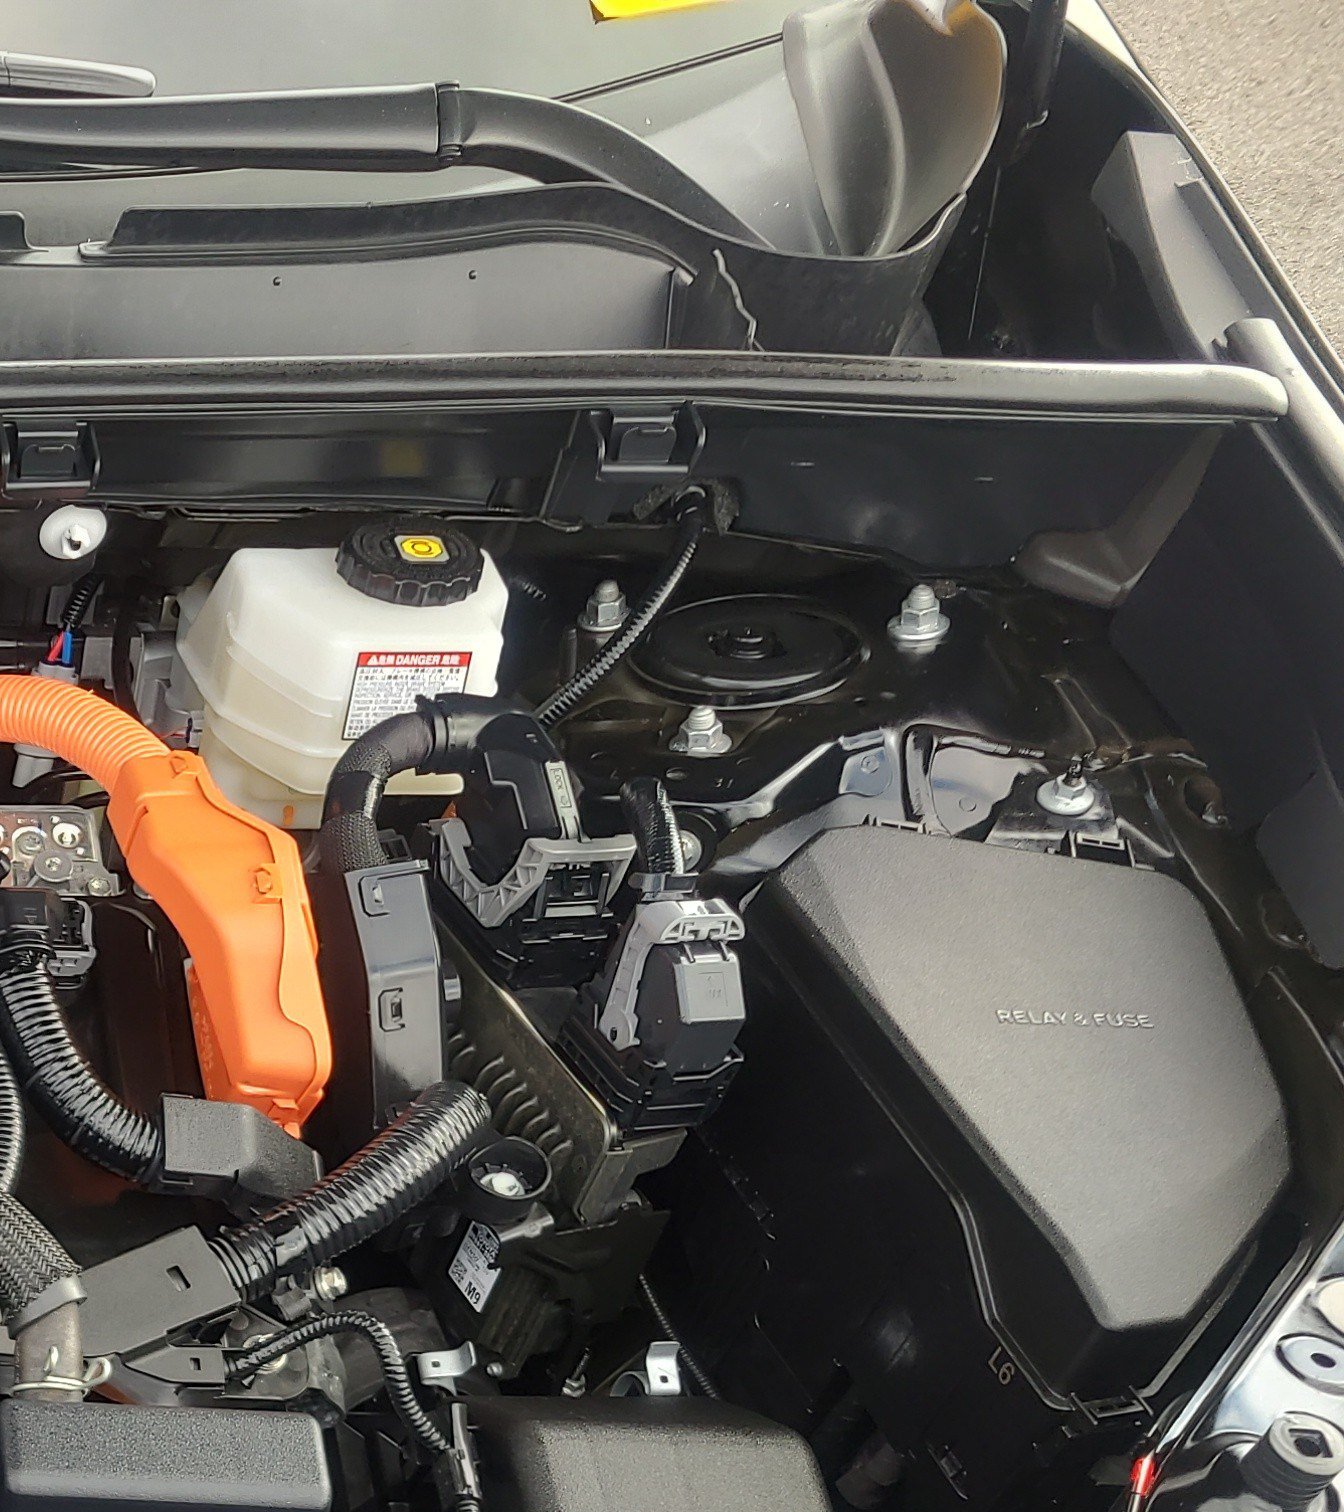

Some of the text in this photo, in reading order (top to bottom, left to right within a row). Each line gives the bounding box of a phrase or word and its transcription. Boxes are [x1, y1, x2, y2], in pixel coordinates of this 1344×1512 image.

[395, 654, 441, 666] DANGER
[996, 1009, 1155, 1029] RELAY & FUSE
[464, 1280, 482, 1305] M9
[988, 1346, 1015, 1385] L6
